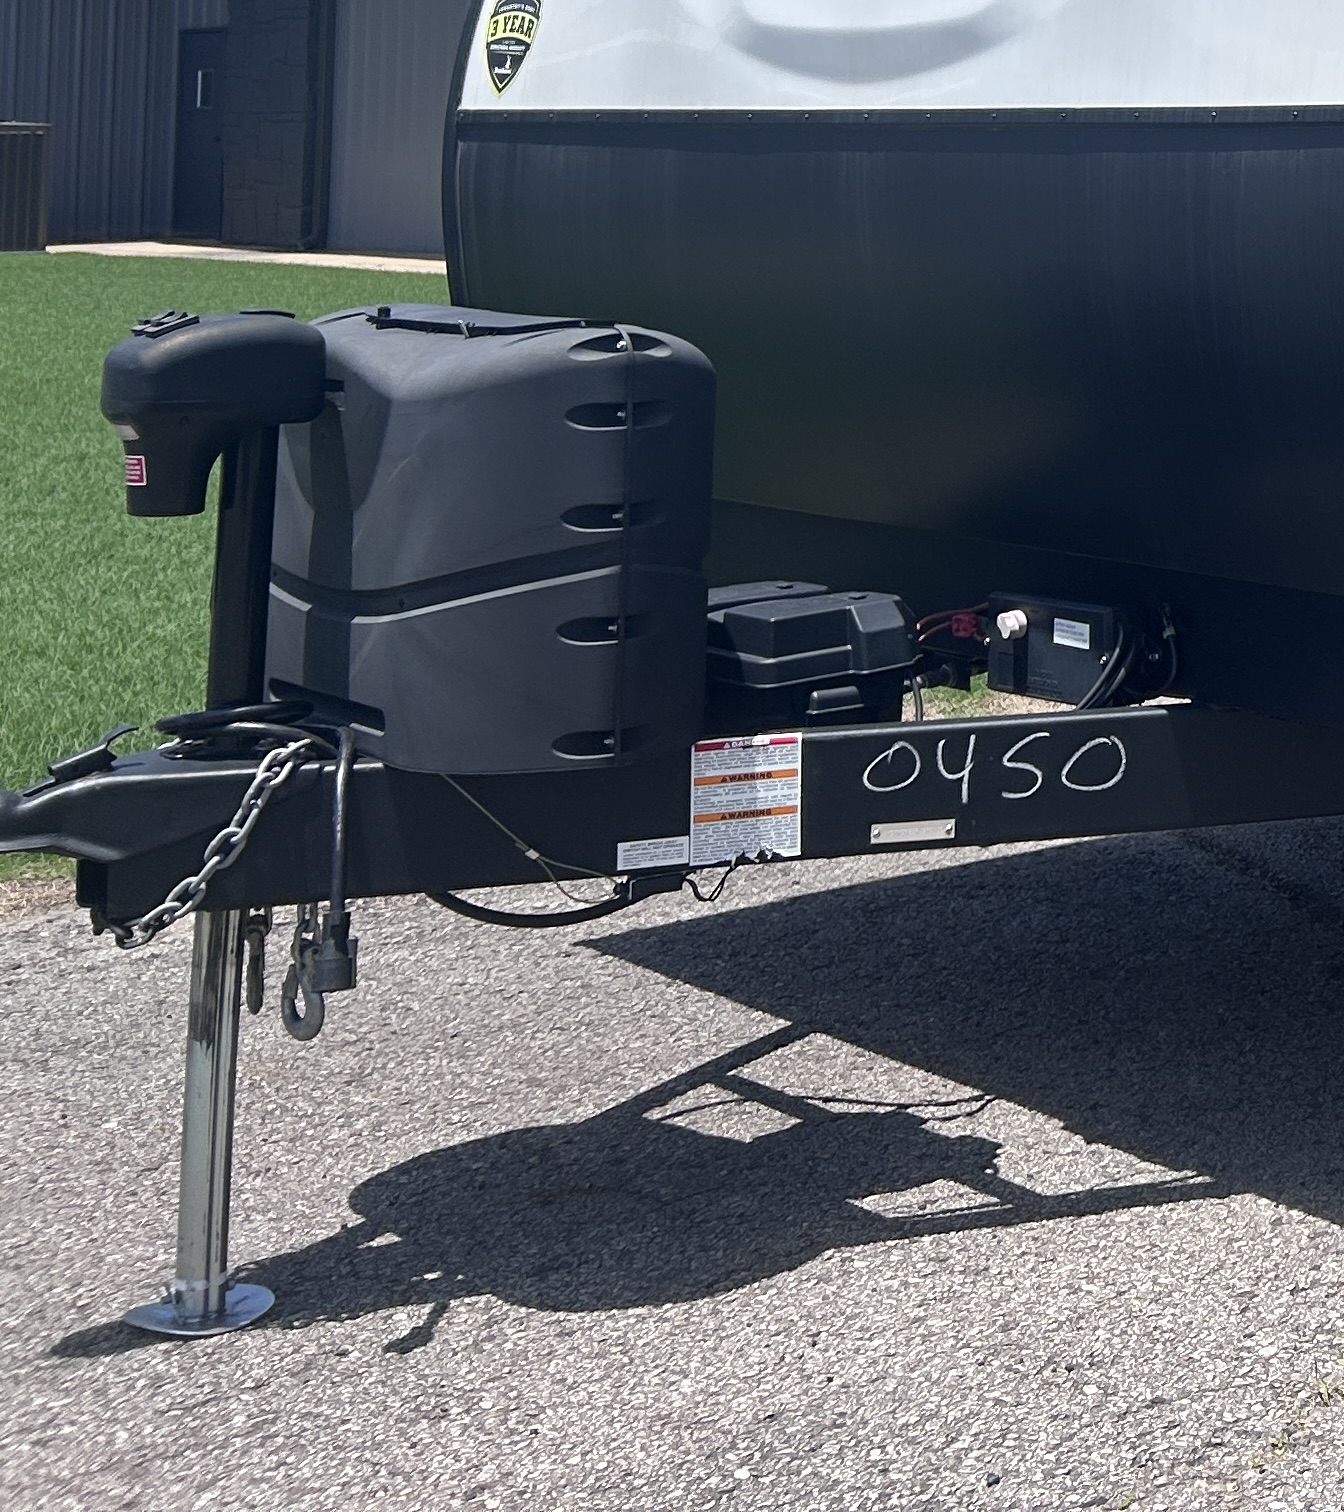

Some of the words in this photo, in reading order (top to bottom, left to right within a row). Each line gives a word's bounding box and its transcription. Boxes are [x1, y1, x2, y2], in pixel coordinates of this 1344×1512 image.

[490, 19, 499, 37] 3
[503, 14, 534, 39] YEAR
[729, 771, 773, 782] WARNING
[729, 808, 772, 820] WARNING
